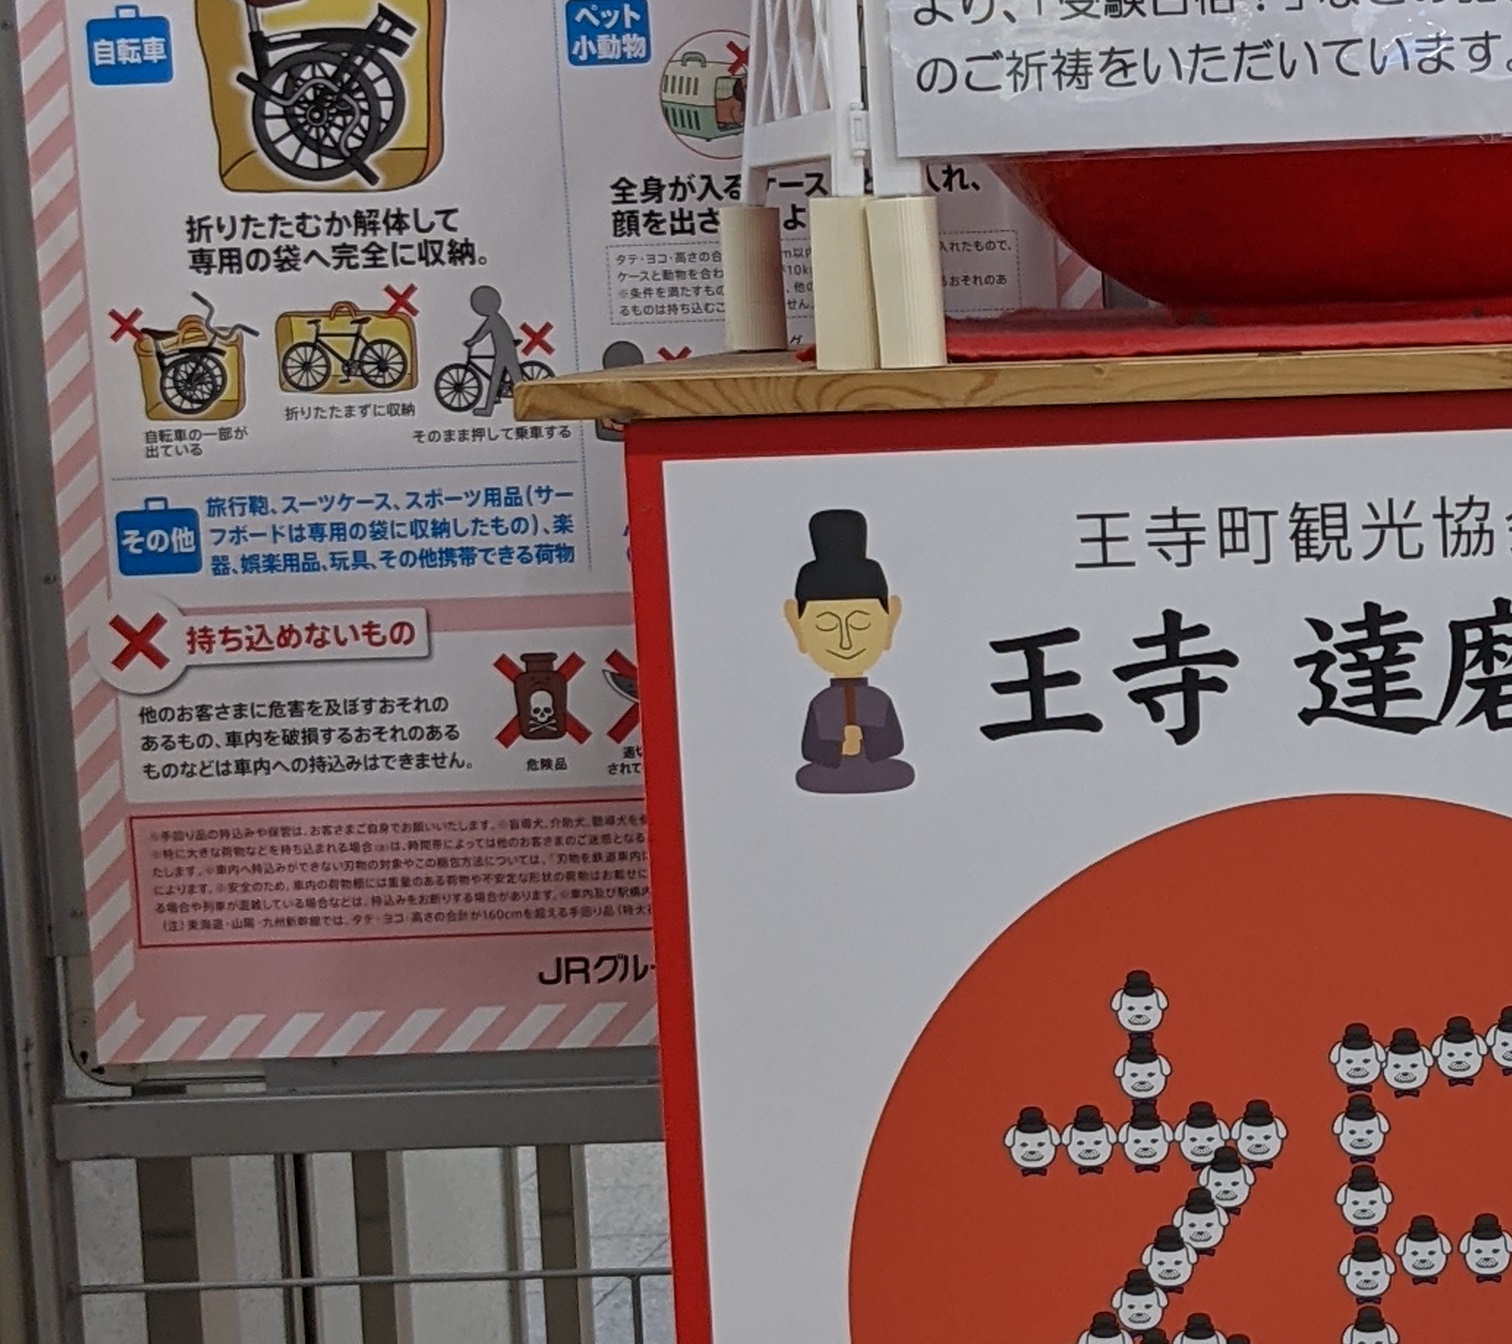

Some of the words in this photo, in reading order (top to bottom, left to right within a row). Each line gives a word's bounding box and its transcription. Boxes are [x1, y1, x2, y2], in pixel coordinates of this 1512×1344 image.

[574, 2, 641, 30] ペット
[92, 36, 167, 67] 自転車
[571, 34, 646, 61] 小動物
[186, 207, 460, 243] 折りたたむか解体して
[188, 239, 488, 276] 専用の袋へ完全に収納。
[285, 402, 416, 421] 折りたたまずに収納
[145, 426, 248, 444] 自転車の一部が
[412, 424, 572, 444] そのまま押して乗車する
[145, 443, 203, 459] 出ている
[121, 526, 196, 554] その他
[187, 619, 416, 655] 持ち込めないもの
[979, 606, 1241, 747] 王寺
[139, 696, 449, 725] 他のお客さまに危害を及ぼすおそれの
[140, 722, 461, 753] あるもの、車内を破損するおそれのある
[526, 757, 568, 773] 危険品
[538, 953, 657, 987] JRグル
